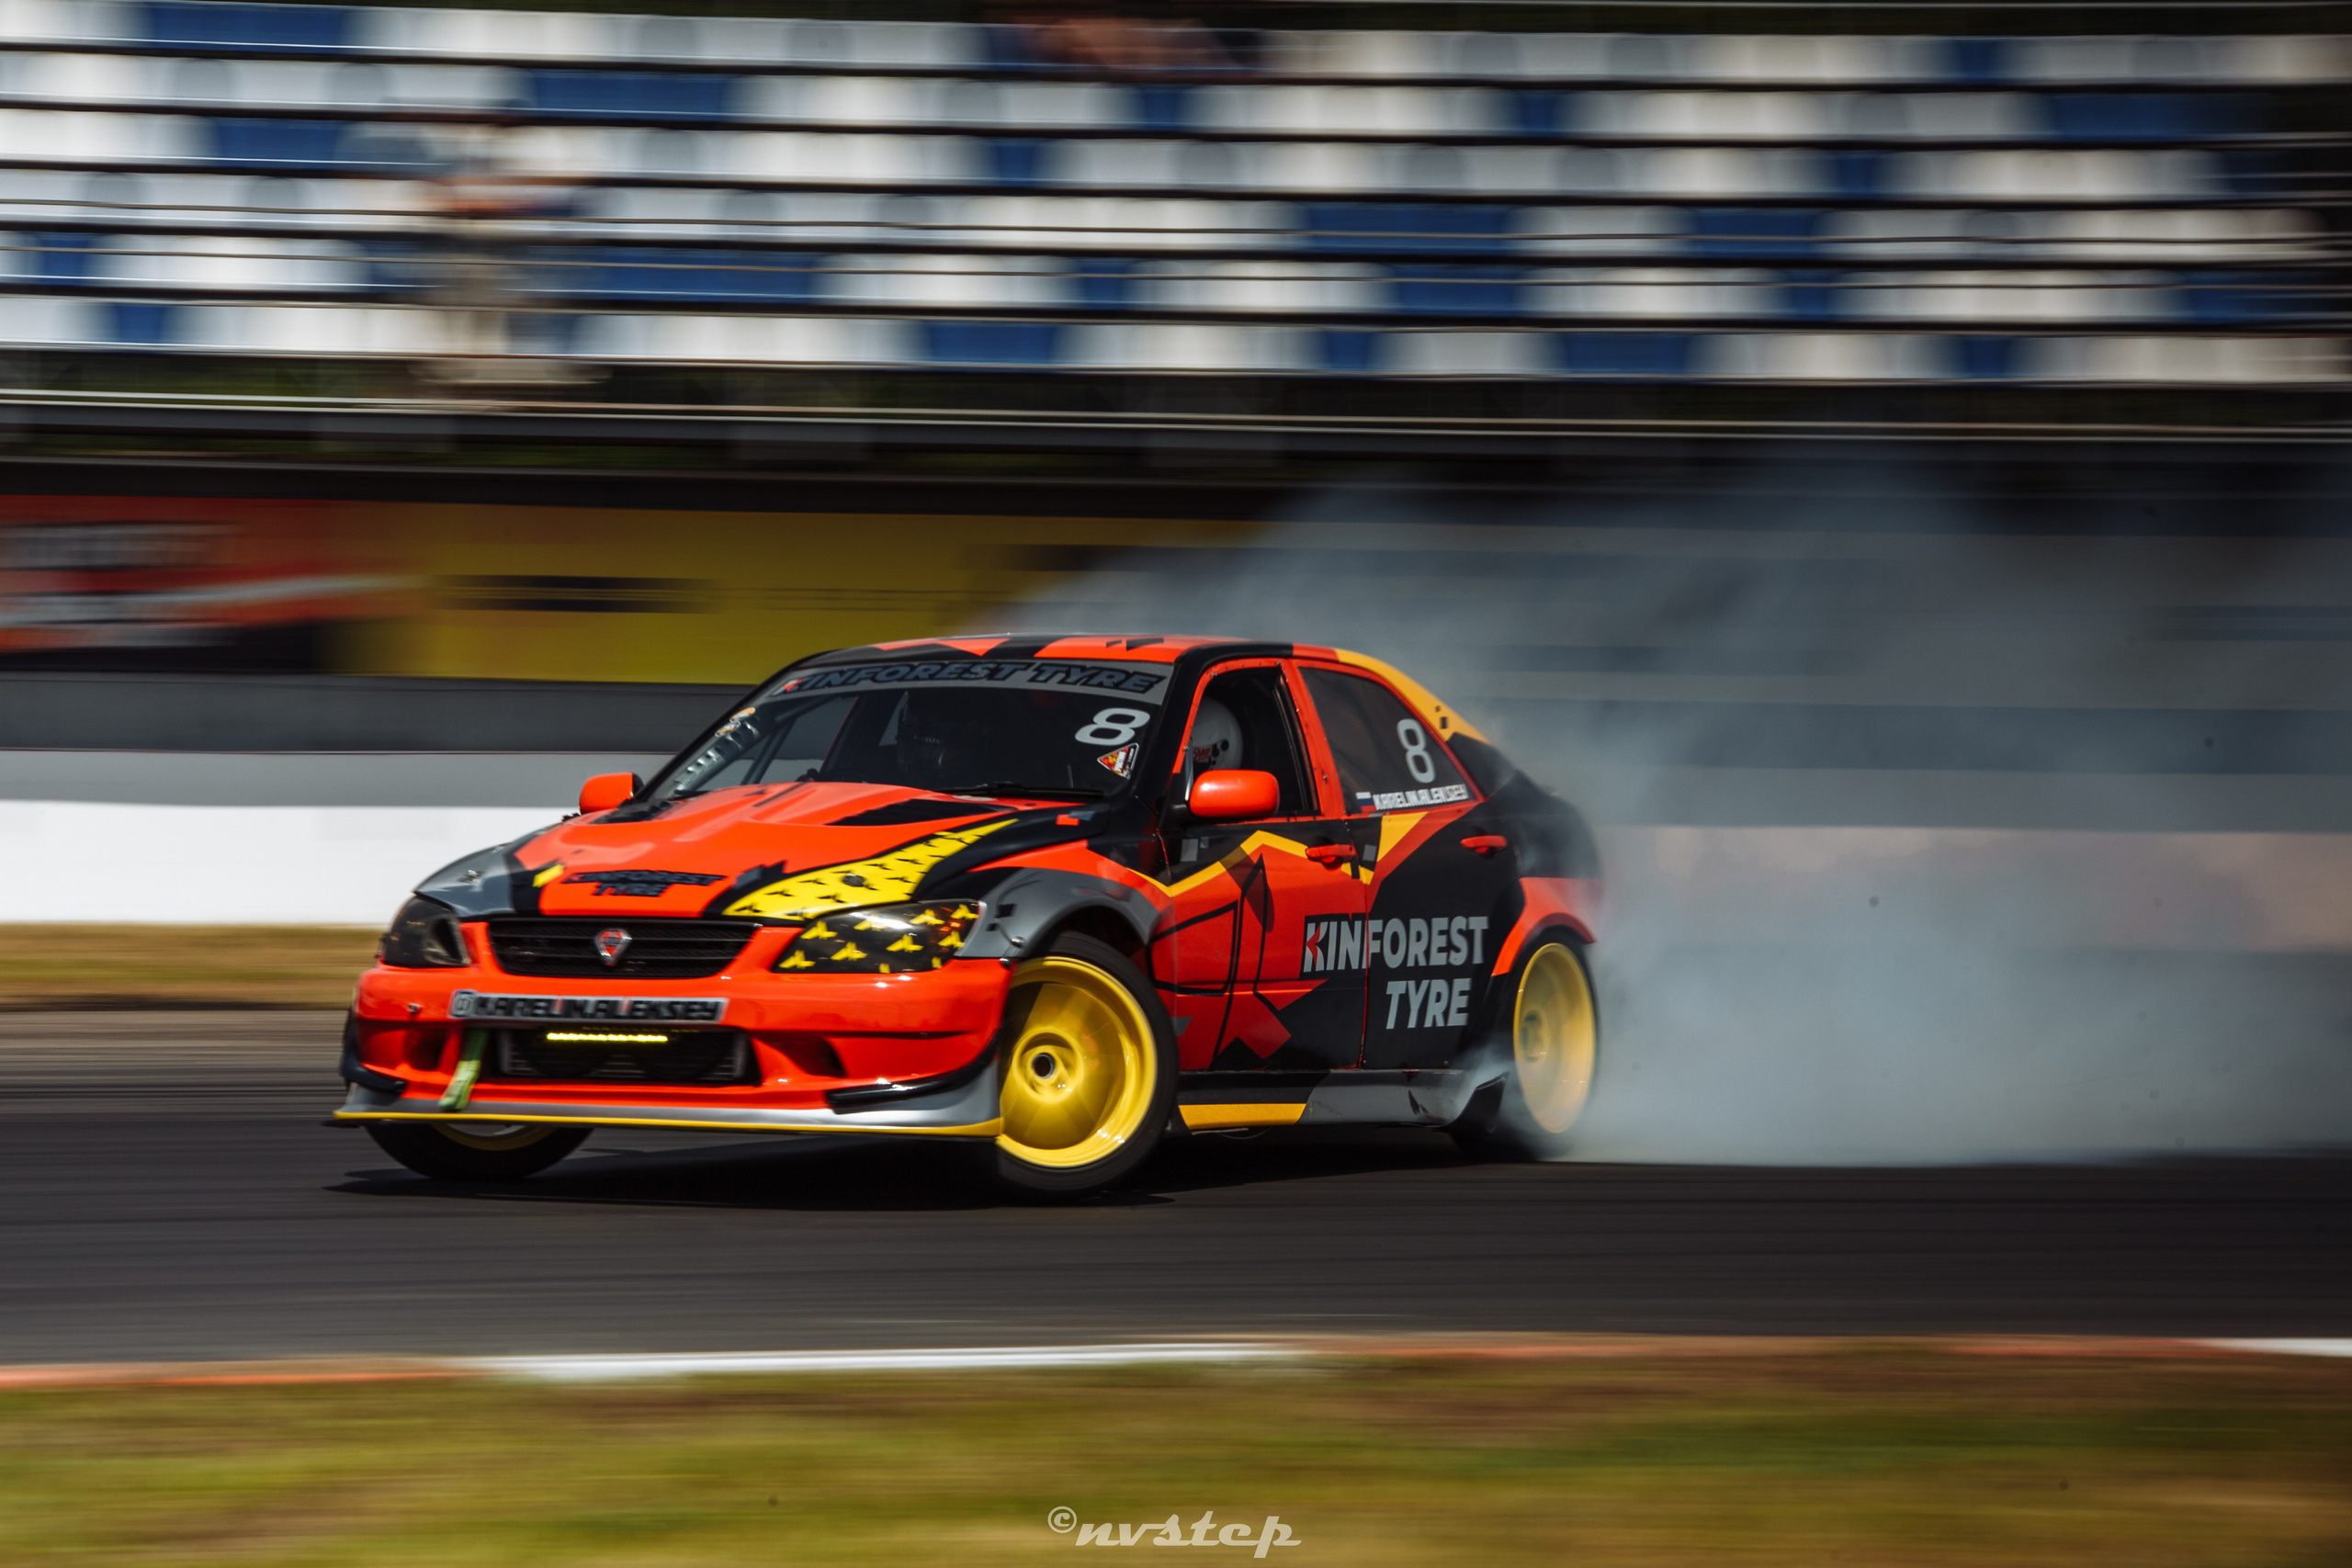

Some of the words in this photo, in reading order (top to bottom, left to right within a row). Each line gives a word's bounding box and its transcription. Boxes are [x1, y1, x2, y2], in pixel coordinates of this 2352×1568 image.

[770, 661, 1035, 695] KINFOREST
[1028, 663, 1166, 694] TYRE
[1075, 707, 1150, 746] 8
[1396, 718, 1436, 784] 8
[1303, 916, 1489, 973] KINFOREST
[1385, 977, 1472, 1030] TYRE
